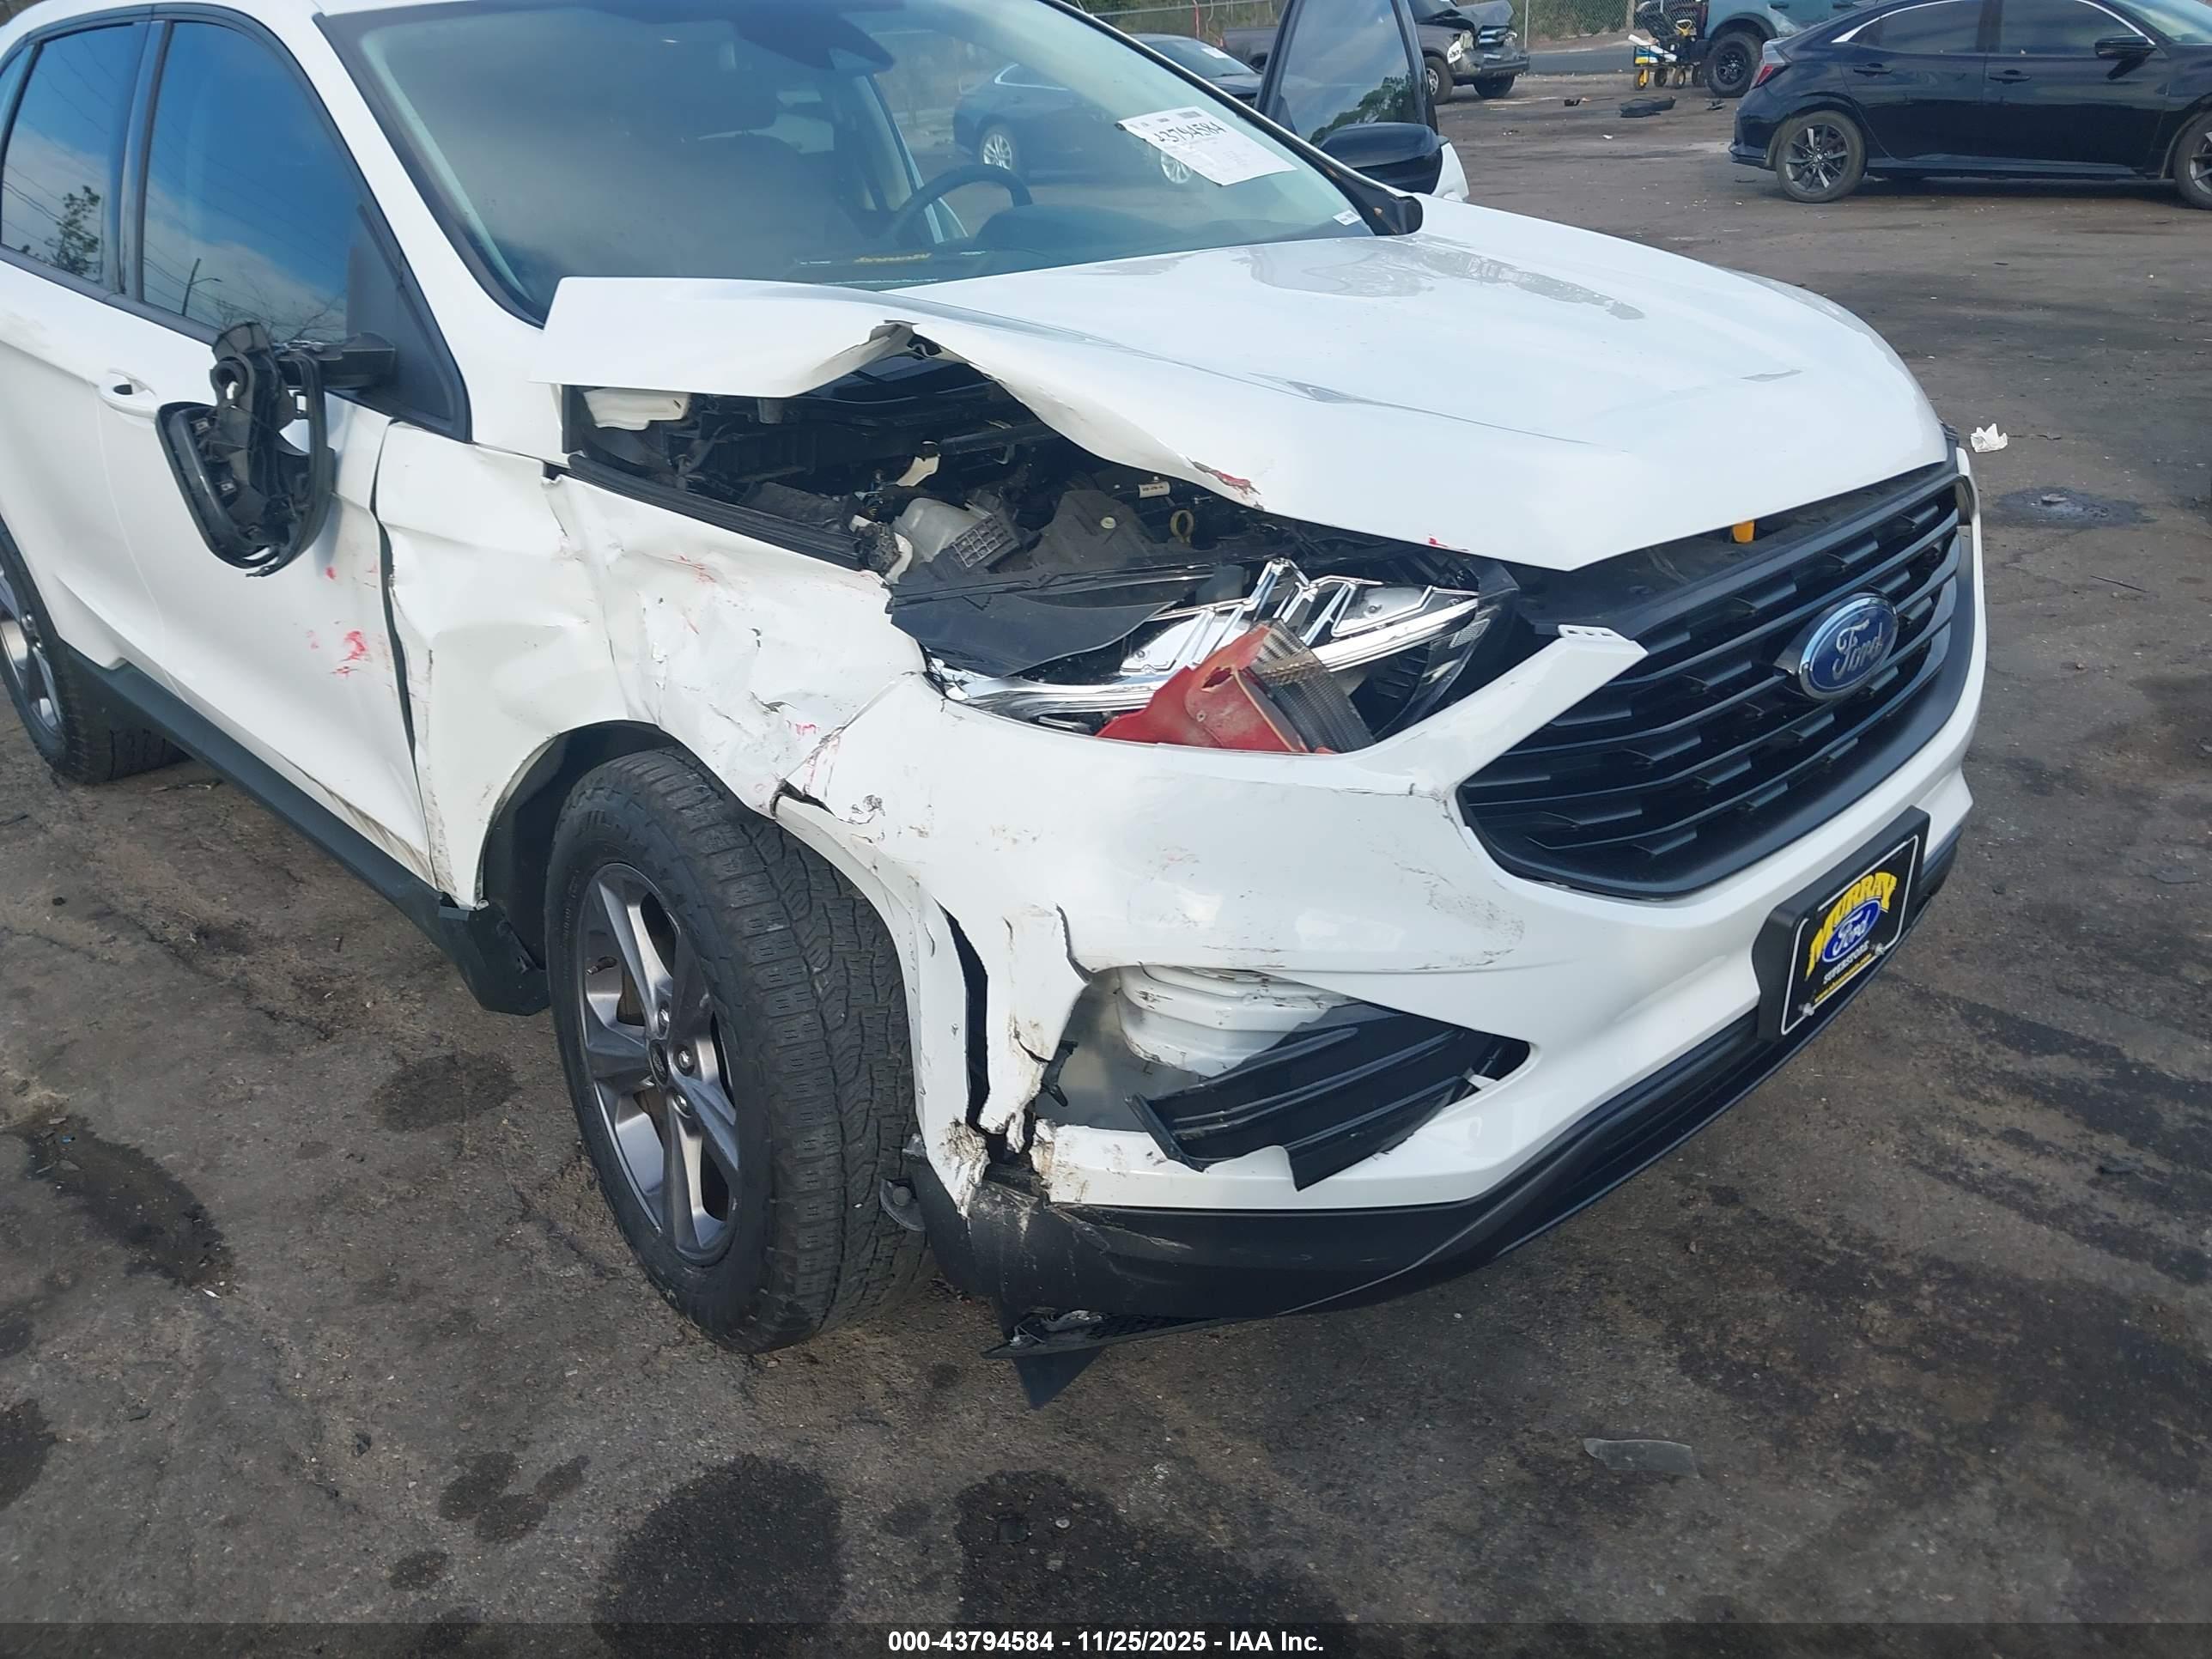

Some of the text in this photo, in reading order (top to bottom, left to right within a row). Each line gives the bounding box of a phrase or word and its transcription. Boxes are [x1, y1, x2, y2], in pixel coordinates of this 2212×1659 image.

[1832, 618, 1882, 680] Ford
[1805, 872, 1898, 981] MURRAY
[1832, 908, 1871, 957] Ford
